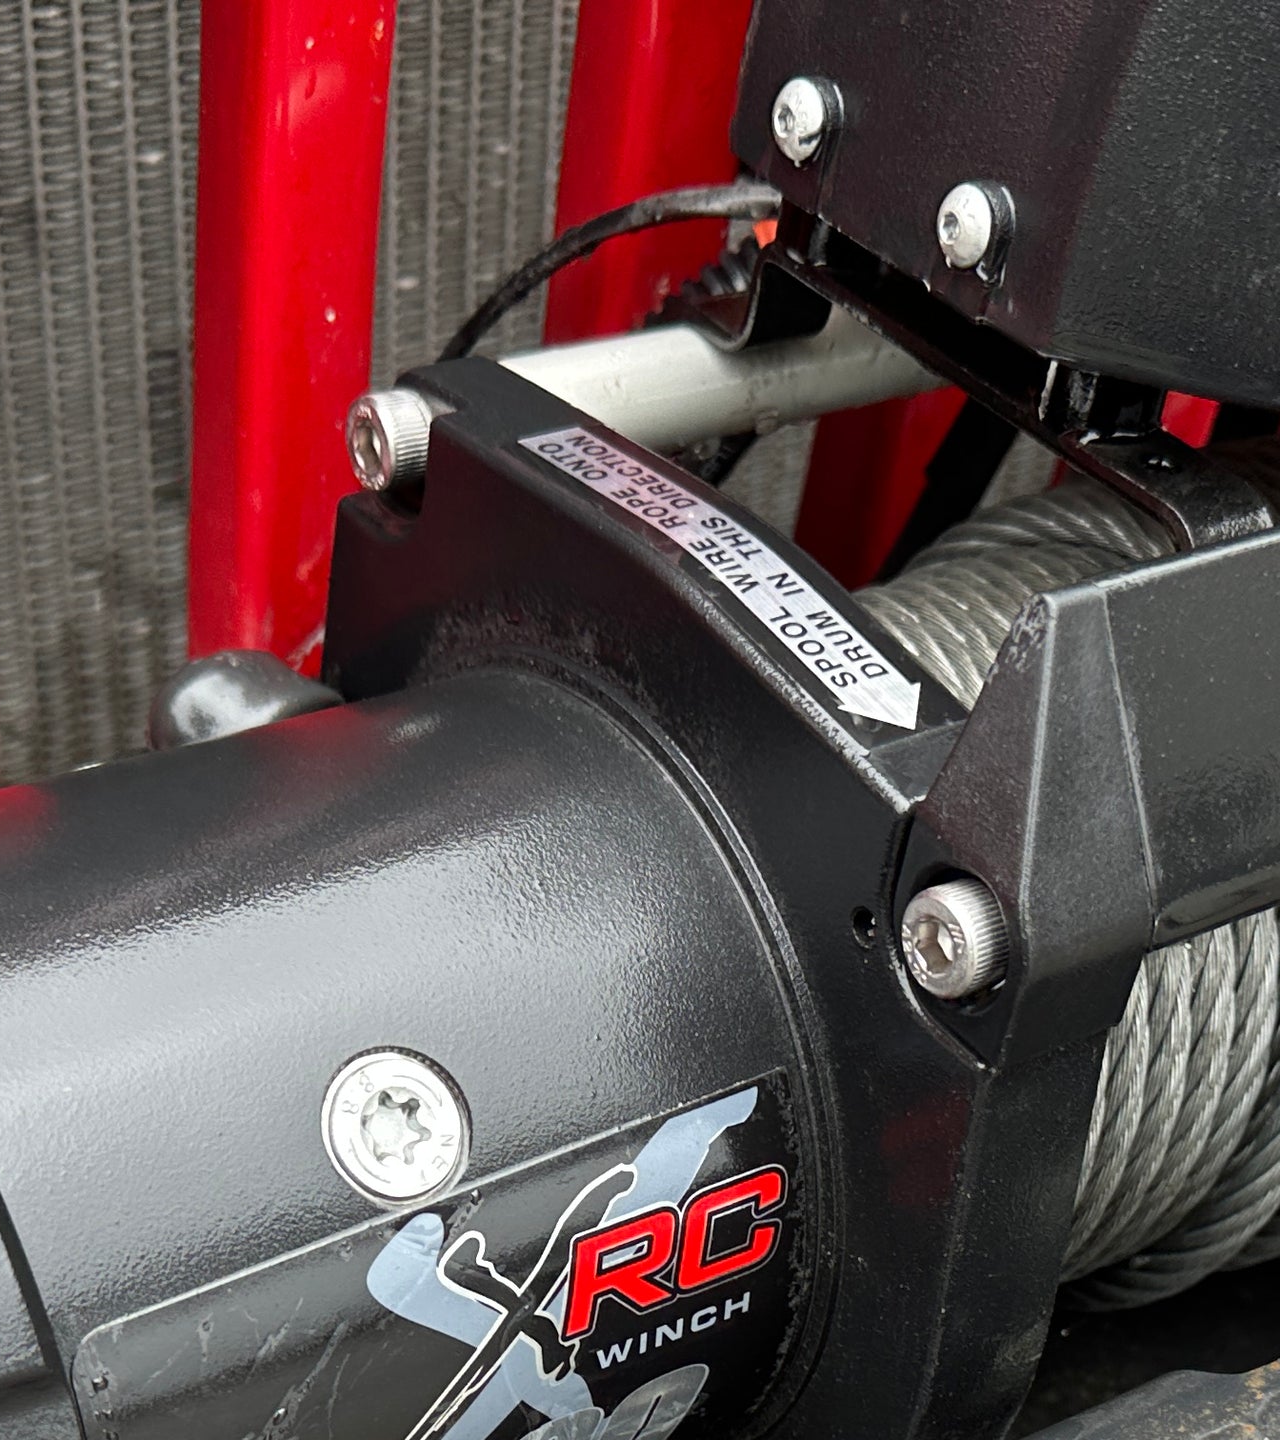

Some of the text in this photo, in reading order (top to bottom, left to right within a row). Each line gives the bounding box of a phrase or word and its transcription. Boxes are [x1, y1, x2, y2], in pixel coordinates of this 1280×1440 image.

[537, 442, 859, 689] SPOOL WIRE ROPE ONTO
[569, 434, 889, 679] DRUM IN THIS DIRECTION
[596, 1292, 750, 1370] WINCH
